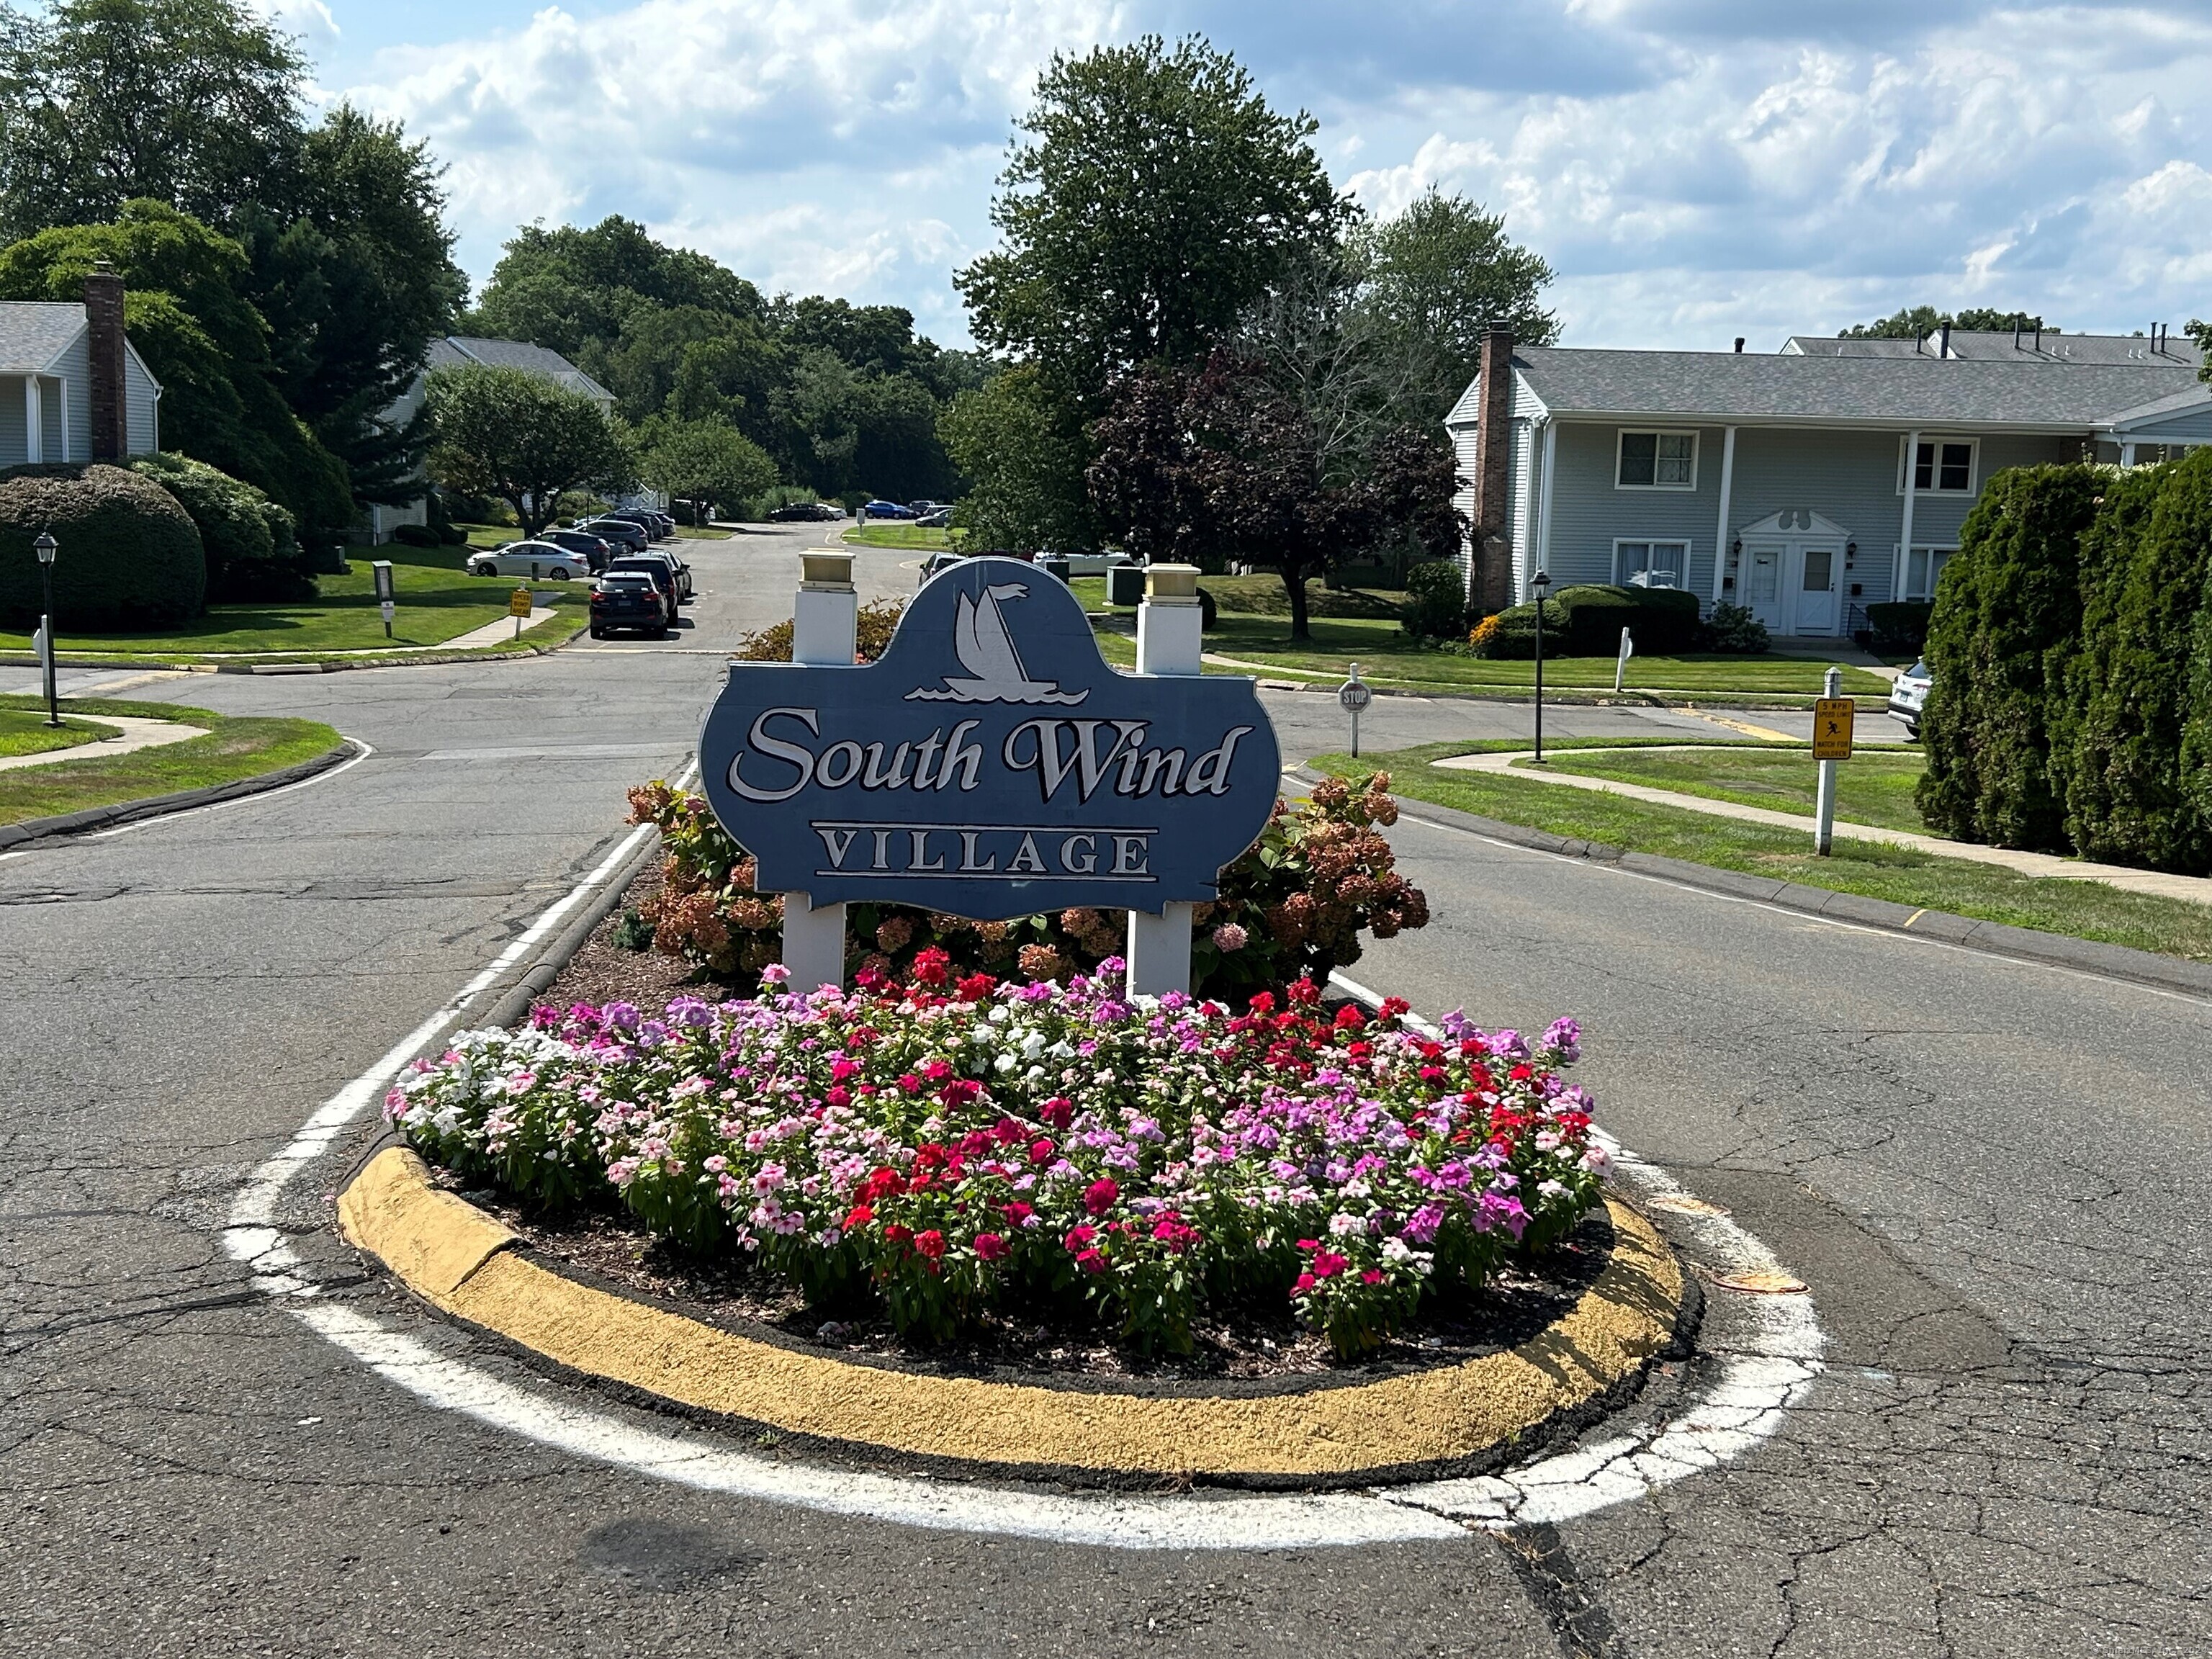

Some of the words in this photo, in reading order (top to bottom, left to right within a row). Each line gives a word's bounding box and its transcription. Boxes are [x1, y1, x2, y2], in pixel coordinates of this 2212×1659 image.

[1344, 691, 1367, 703] STOP
[727, 706, 984, 802] South
[1002, 719, 1254, 804] Wind
[815, 829, 1151, 875] VILLAGE
